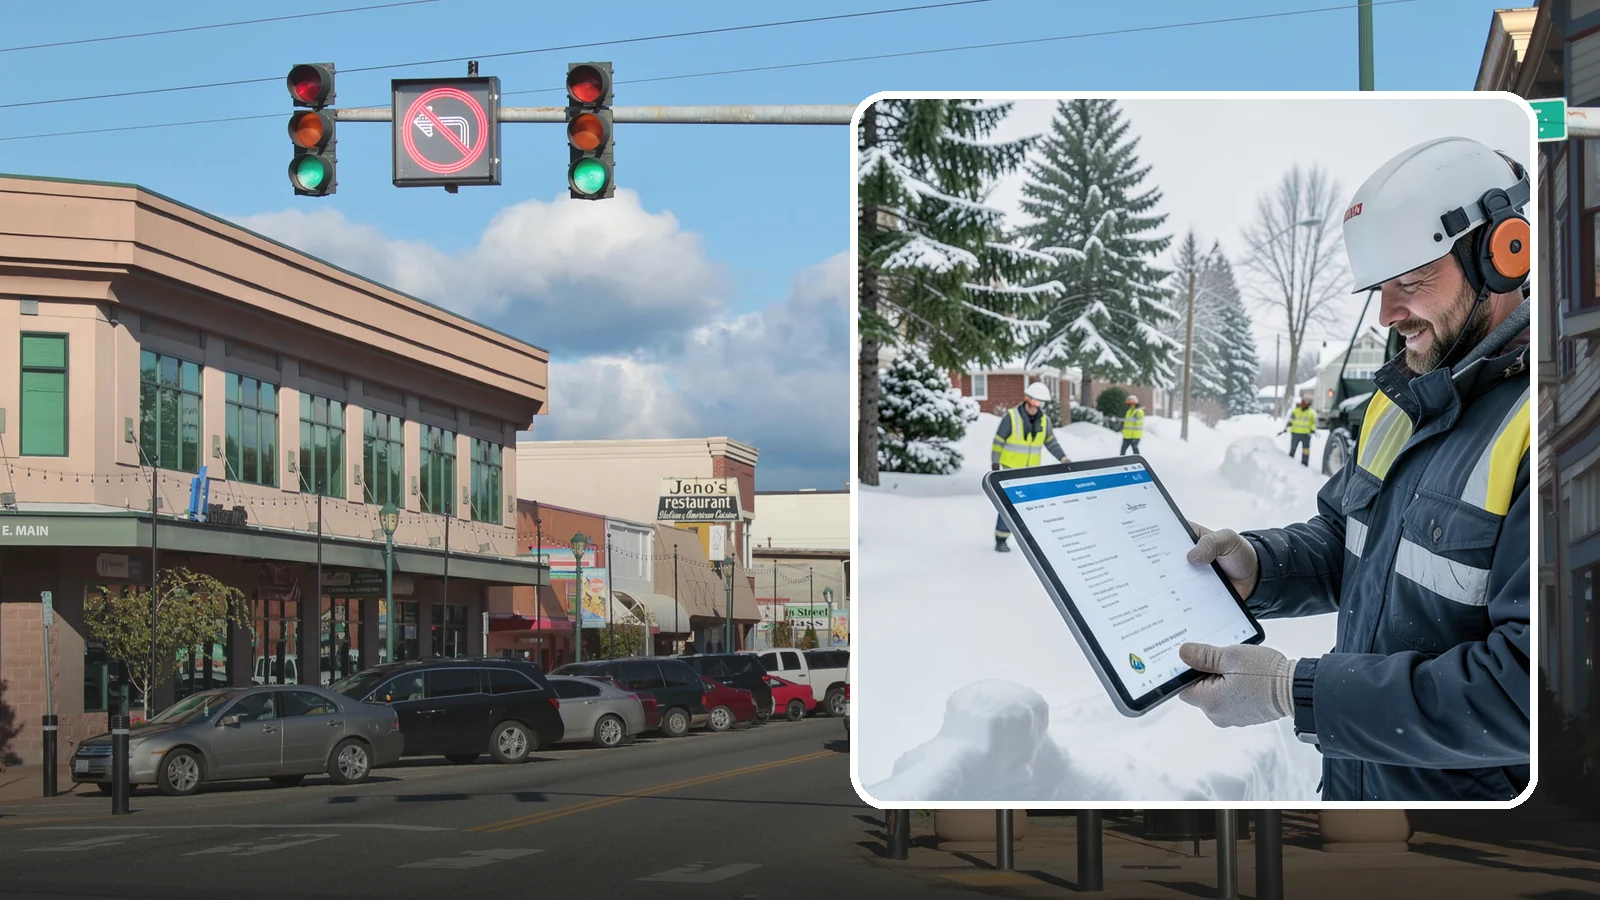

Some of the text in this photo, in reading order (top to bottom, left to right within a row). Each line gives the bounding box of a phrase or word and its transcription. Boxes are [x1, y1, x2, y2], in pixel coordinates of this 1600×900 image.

[670, 480, 727, 494] Jeno's
[665, 497, 731, 508] restaurant
[659, 510, 682, 519] Italian
[685, 510, 714, 519] American
[715, 509, 738, 519] Cuisine
[2, 525, 49, 536] E. MAIN
[797, 608, 828, 616] Street
[791, 619, 824, 627] lass
